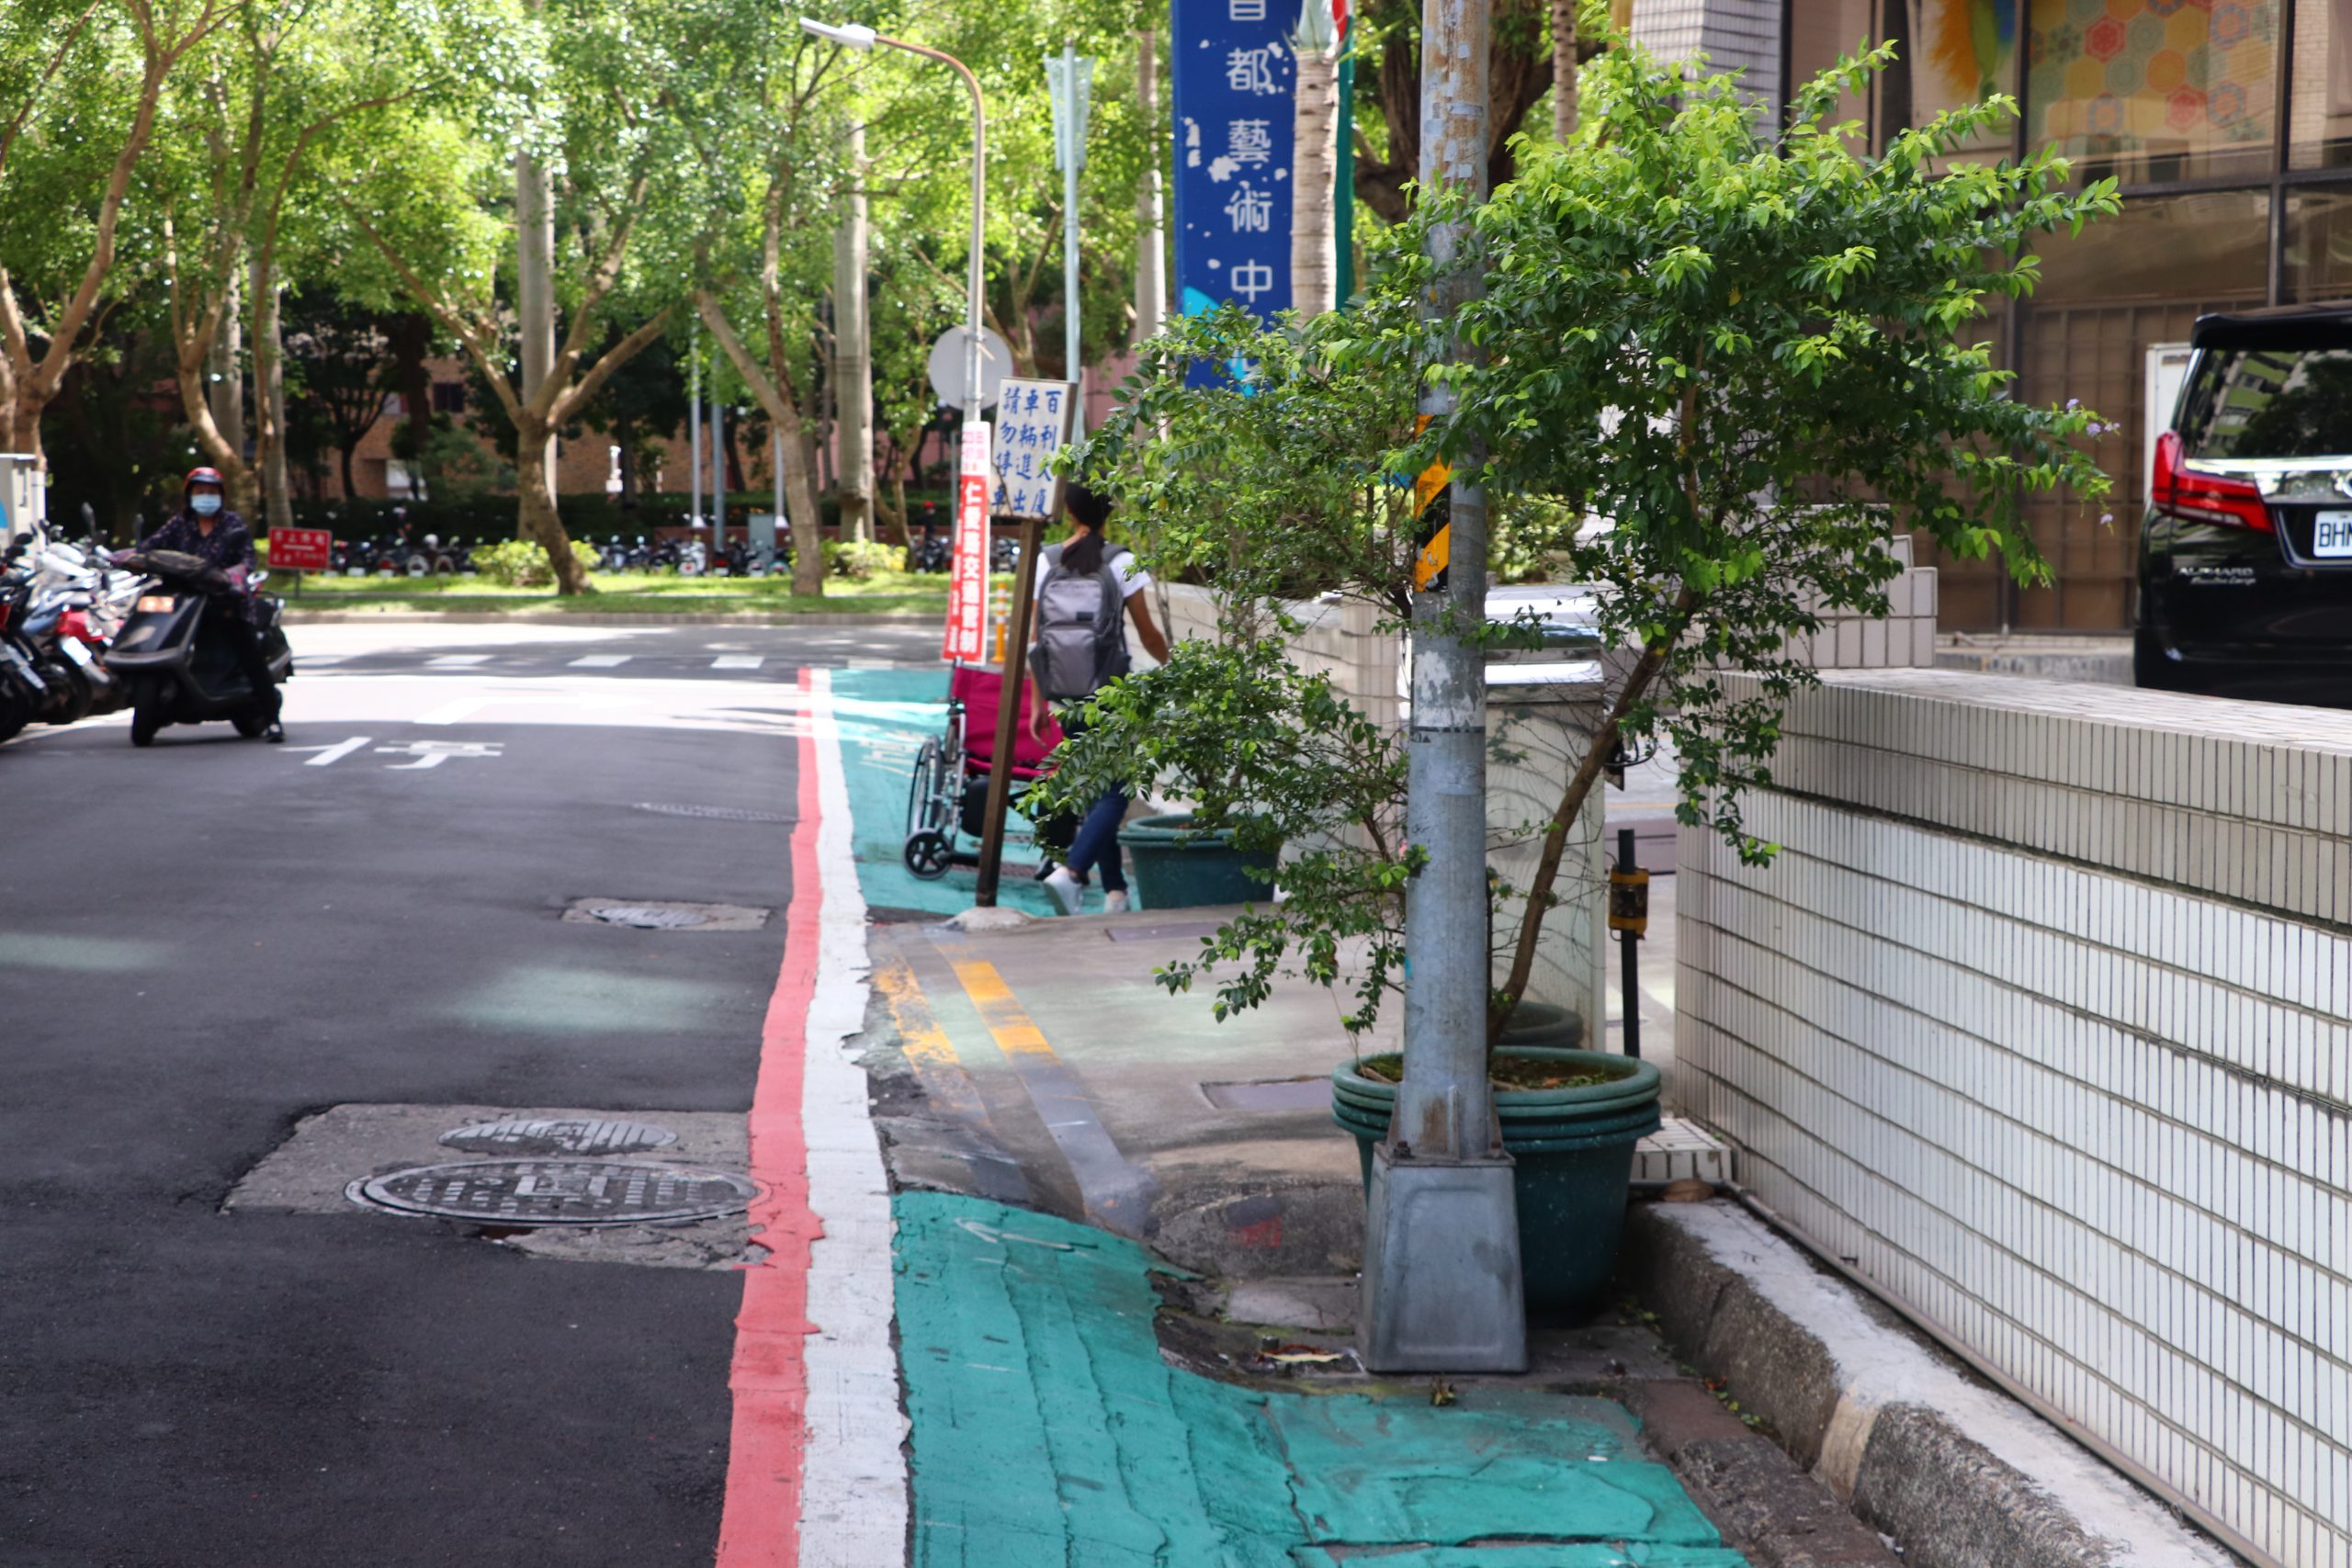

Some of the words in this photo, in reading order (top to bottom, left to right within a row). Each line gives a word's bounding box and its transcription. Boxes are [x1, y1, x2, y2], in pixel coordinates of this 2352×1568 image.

[1226, 0, 1273, 371] 都藝術中
[991, 387, 1021, 514] 請勿停車
[1014, 389, 1039, 512] 車輛進出
